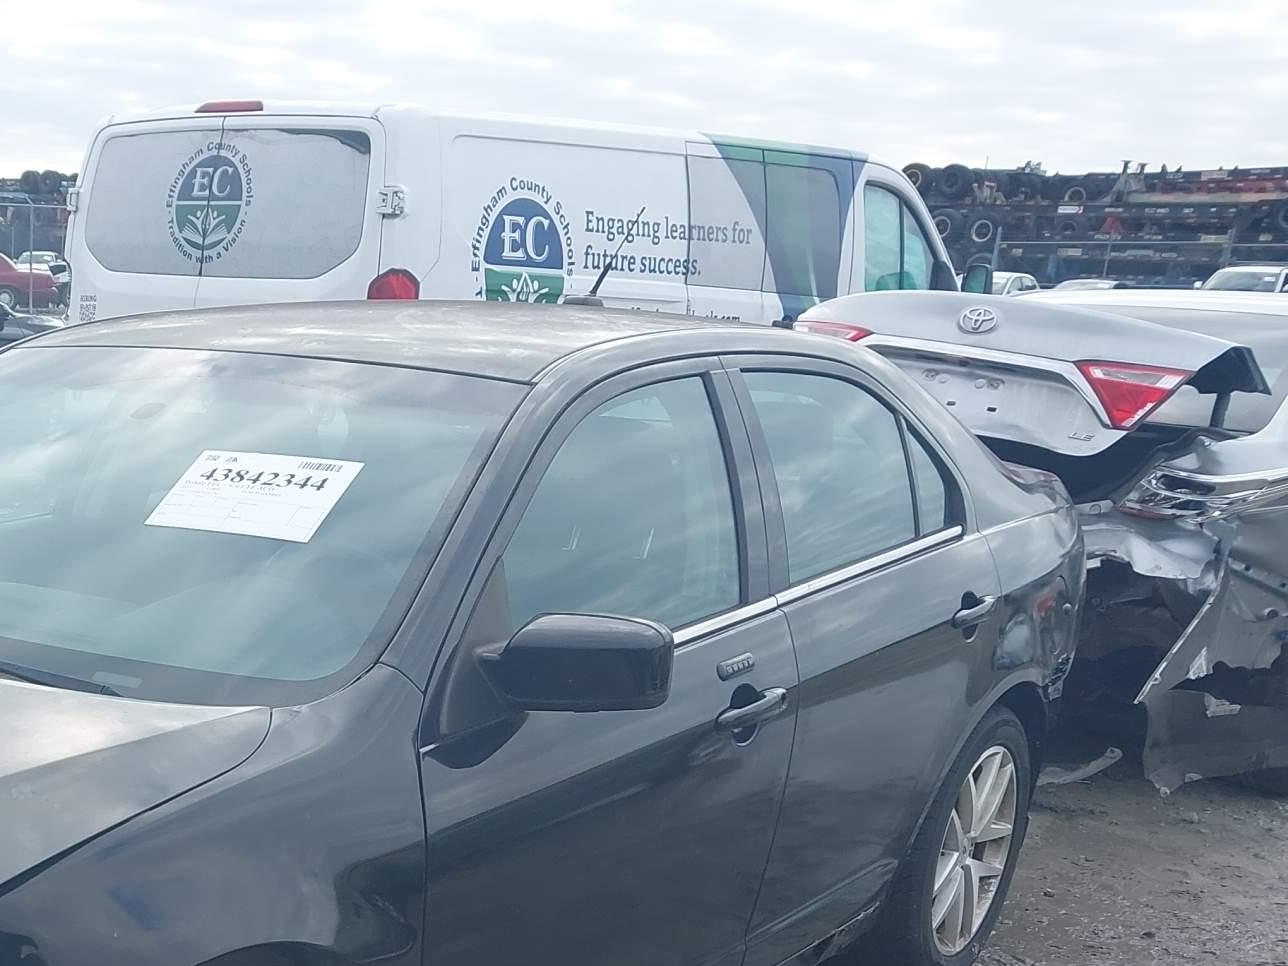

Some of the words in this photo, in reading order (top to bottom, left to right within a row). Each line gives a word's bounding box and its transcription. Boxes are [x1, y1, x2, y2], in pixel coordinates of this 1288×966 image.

[166, 148, 203, 208] Effingham
[207, 141, 241, 159] County
[240, 154, 254, 207] Schools
[191, 166, 234, 197] EC
[168, 216, 193, 262] Tradition
[222, 219, 247, 252] Vision
[471, 185, 508, 271] Effingham
[510, 177, 553, 205] County
[554, 201, 576, 276] Schools
[500, 214, 551, 262] EC
[584, 210, 662, 245] Engaging
[664, 216, 729, 243] learners
[731, 221, 753, 245] for
[583, 245, 637, 273] future
[639, 254, 702, 276] success.
[199, 467, 329, 491] 43842344
